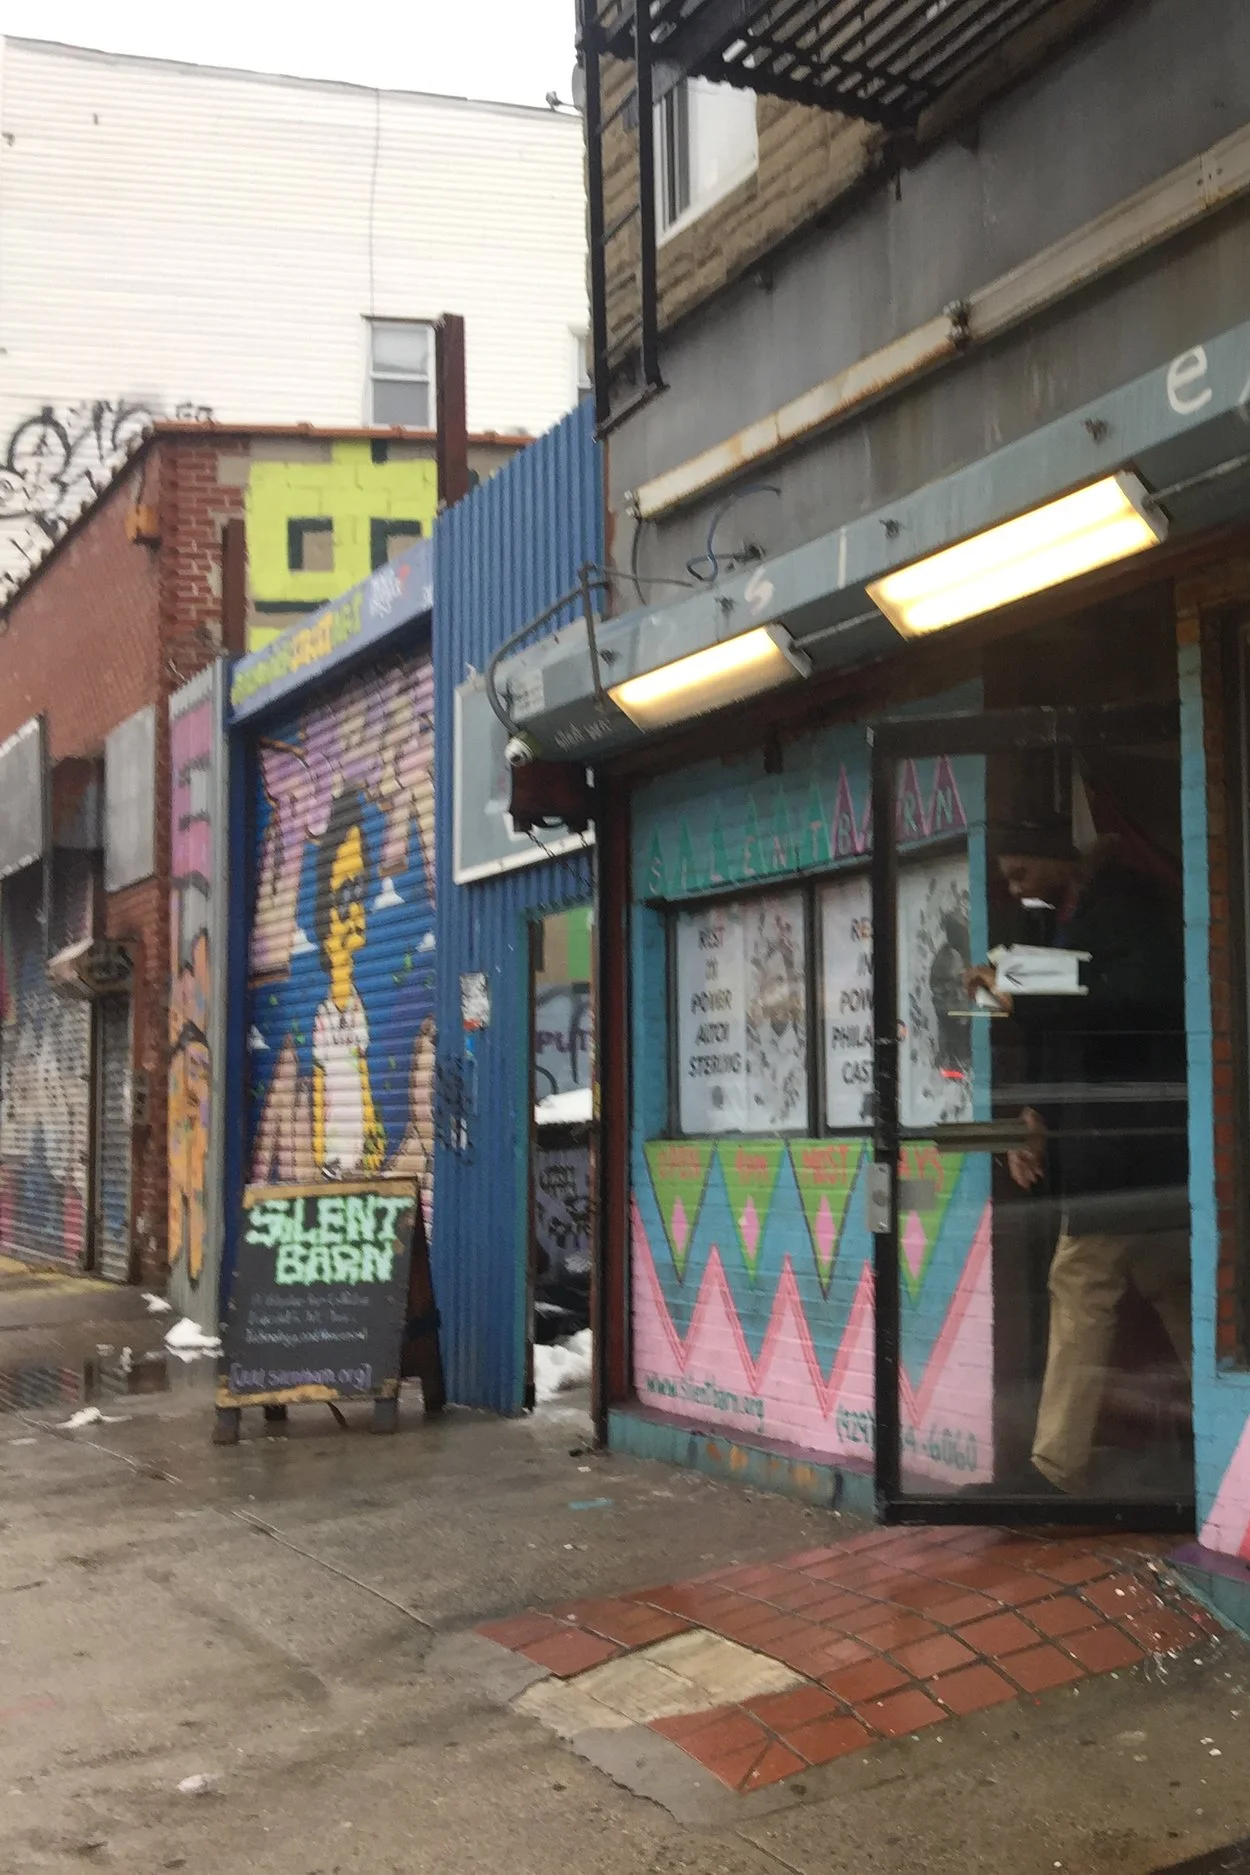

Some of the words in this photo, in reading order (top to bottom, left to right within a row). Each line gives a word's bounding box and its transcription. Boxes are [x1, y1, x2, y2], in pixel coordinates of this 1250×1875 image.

[838, 786, 953, 855] BRN
[839, 988, 874, 1013] POW
[244, 1195, 415, 1248] SILENT
[275, 1241, 394, 1286] BARN
